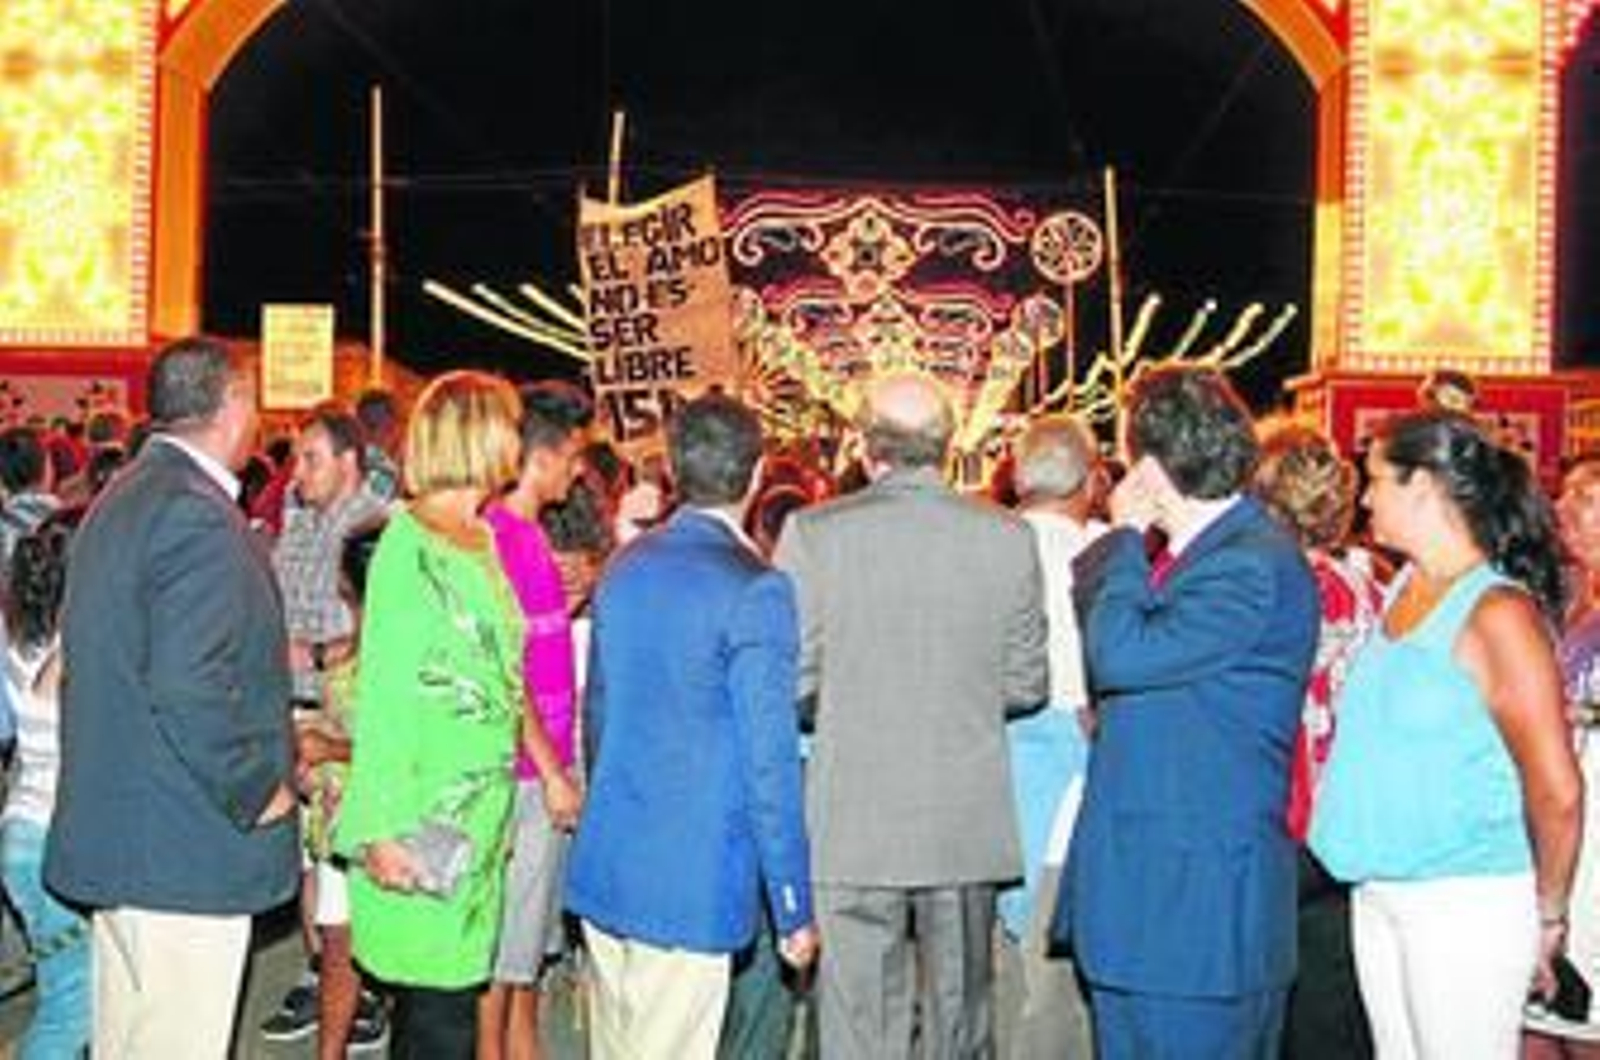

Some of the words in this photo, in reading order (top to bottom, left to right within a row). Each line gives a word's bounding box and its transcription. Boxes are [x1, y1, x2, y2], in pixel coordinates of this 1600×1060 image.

[588, 254, 629, 280] EL
[647, 237, 721, 274] AMO
[590, 285, 639, 315] NO
[647, 279, 687, 308] ES
[590, 313, 659, 349] SER
[596, 348, 695, 385] LIBRE
